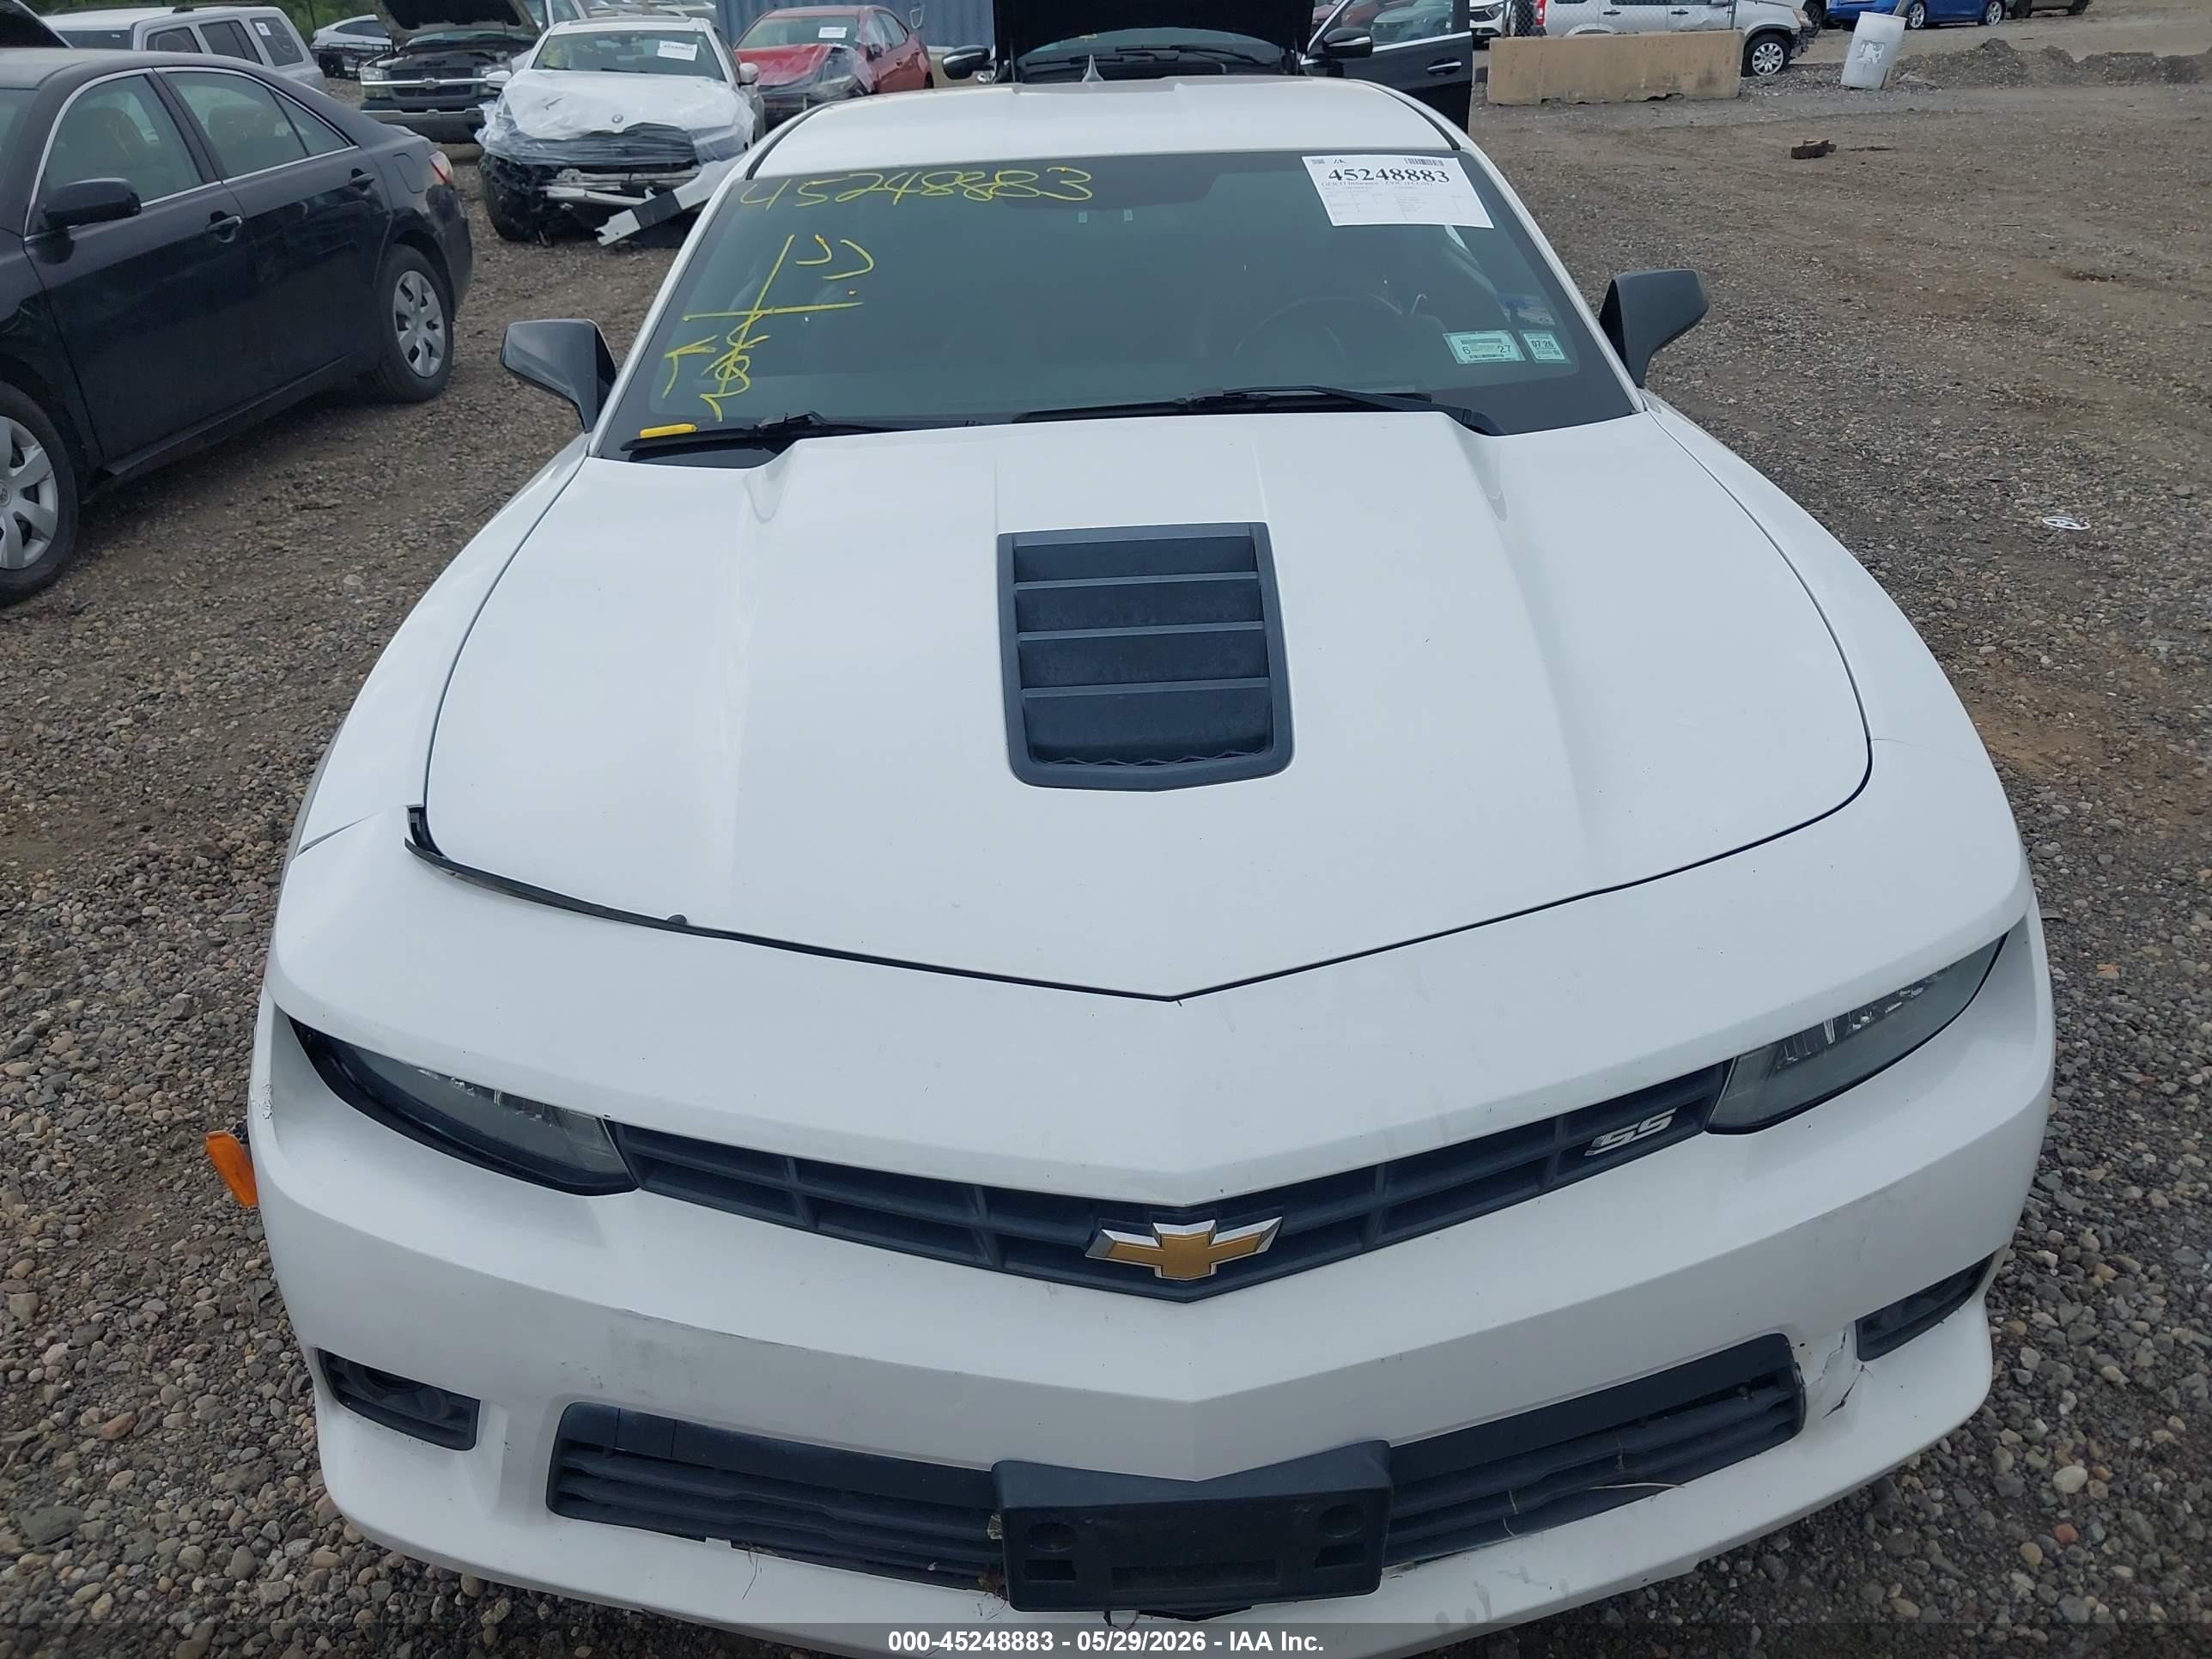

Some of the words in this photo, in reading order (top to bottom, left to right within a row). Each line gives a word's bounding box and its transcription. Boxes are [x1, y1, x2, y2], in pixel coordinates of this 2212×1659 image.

[740, 167, 1093, 210] 45248883
[1328, 168, 1450, 183] 45248883
[1462, 346, 1471, 355] 6
[1497, 344, 1511, 353] 27
[1584, 1107, 1678, 1157] SS
